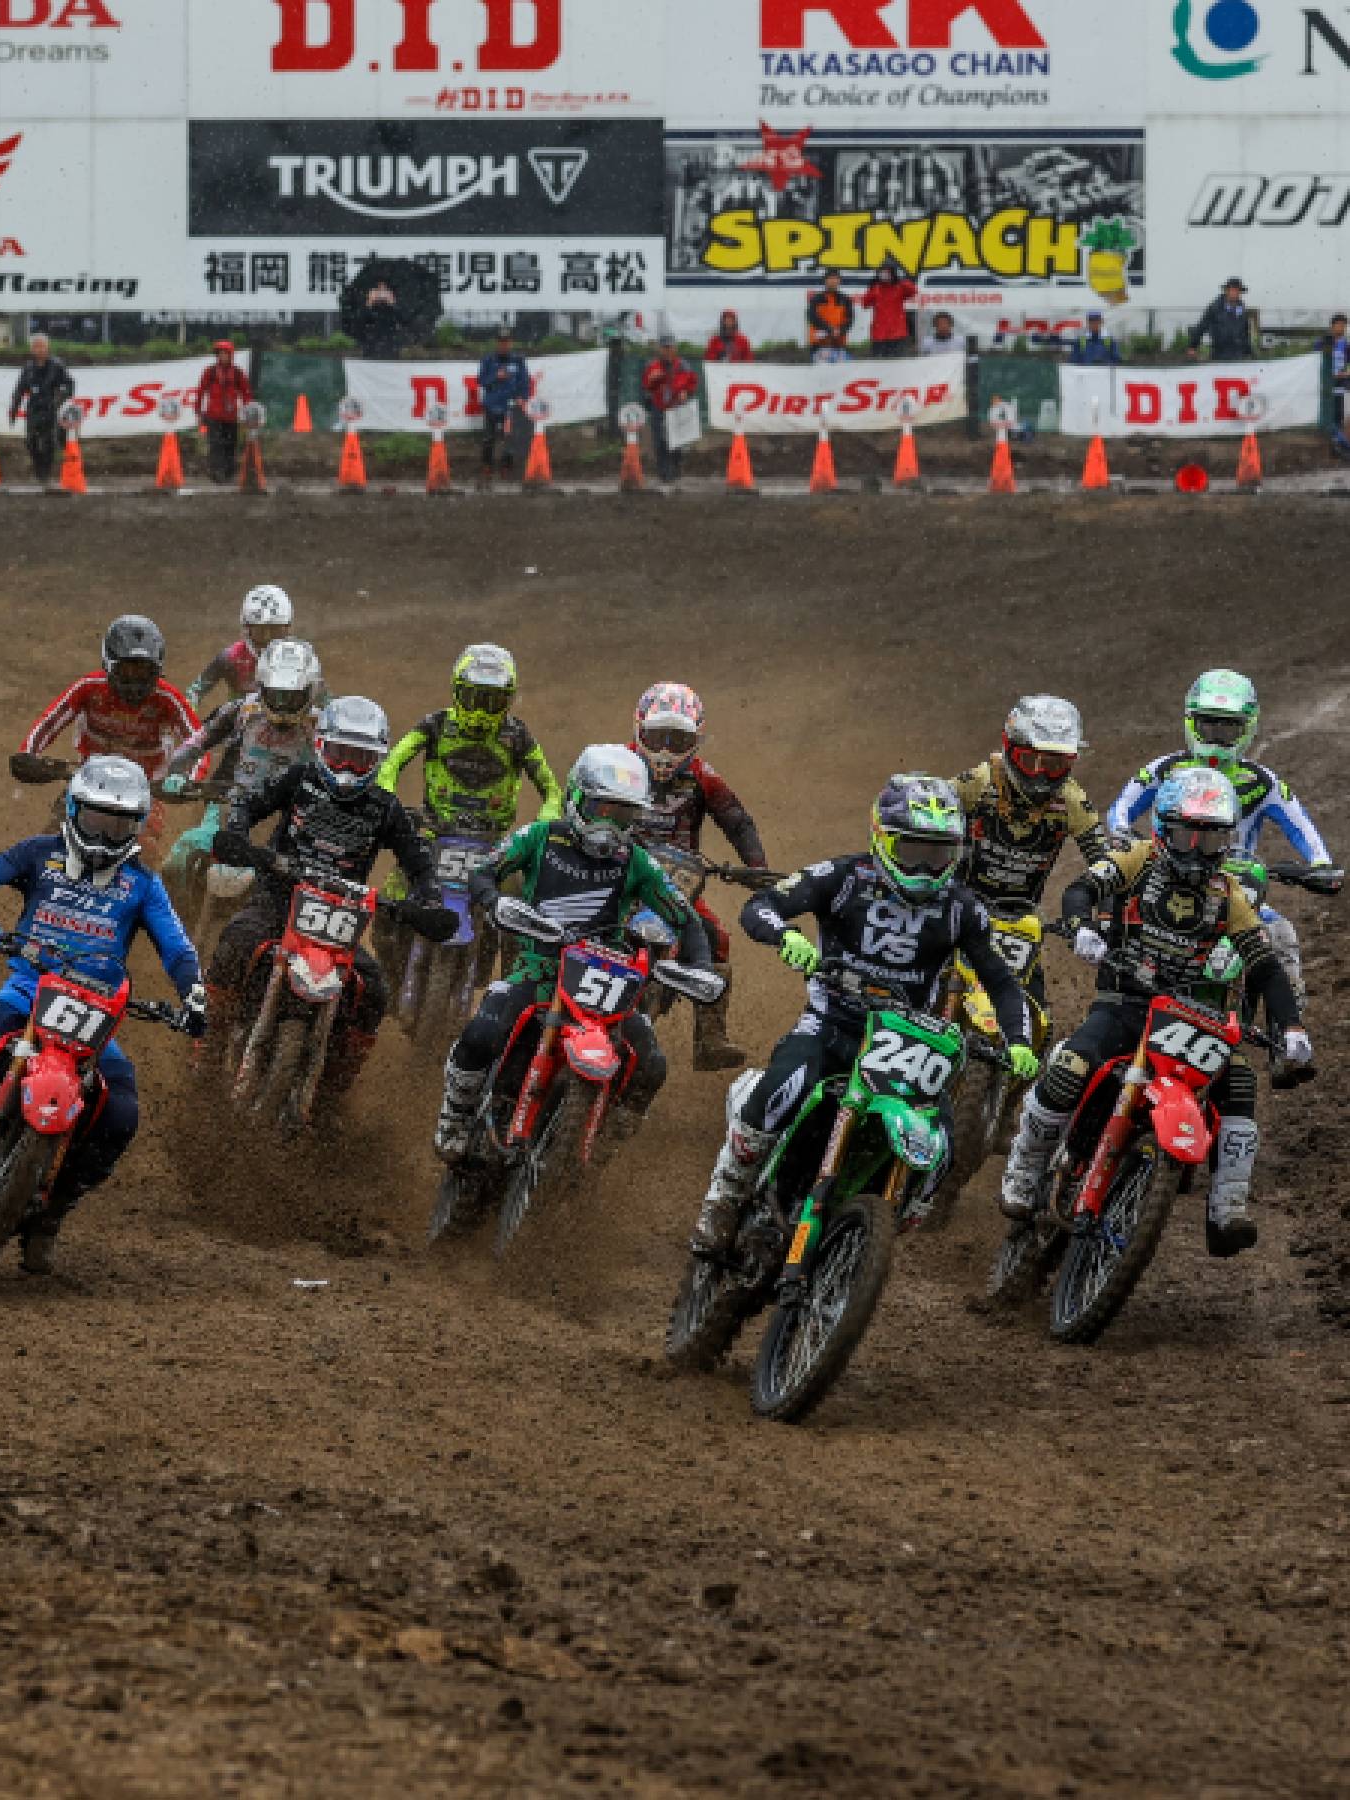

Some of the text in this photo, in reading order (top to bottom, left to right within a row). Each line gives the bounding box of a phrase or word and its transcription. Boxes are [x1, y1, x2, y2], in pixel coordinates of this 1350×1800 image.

[760, 52, 1050, 76] TAKASAGO CHAIN
[759, 83, 1050, 110] The Choice of Champions
[269, 155, 520, 211] TRIUMPH
[703, 208, 1081, 278] SPINACH
[204, 251, 291, 294] 福岡
[558, 251, 647, 294] 高松
[296, 899, 357, 940] 56
[575, 968, 629, 1012] 51
[46, 995, 107, 1039] 61
[861, 1030, 952, 1095] 240
[1151, 1022, 1232, 1074] 46
